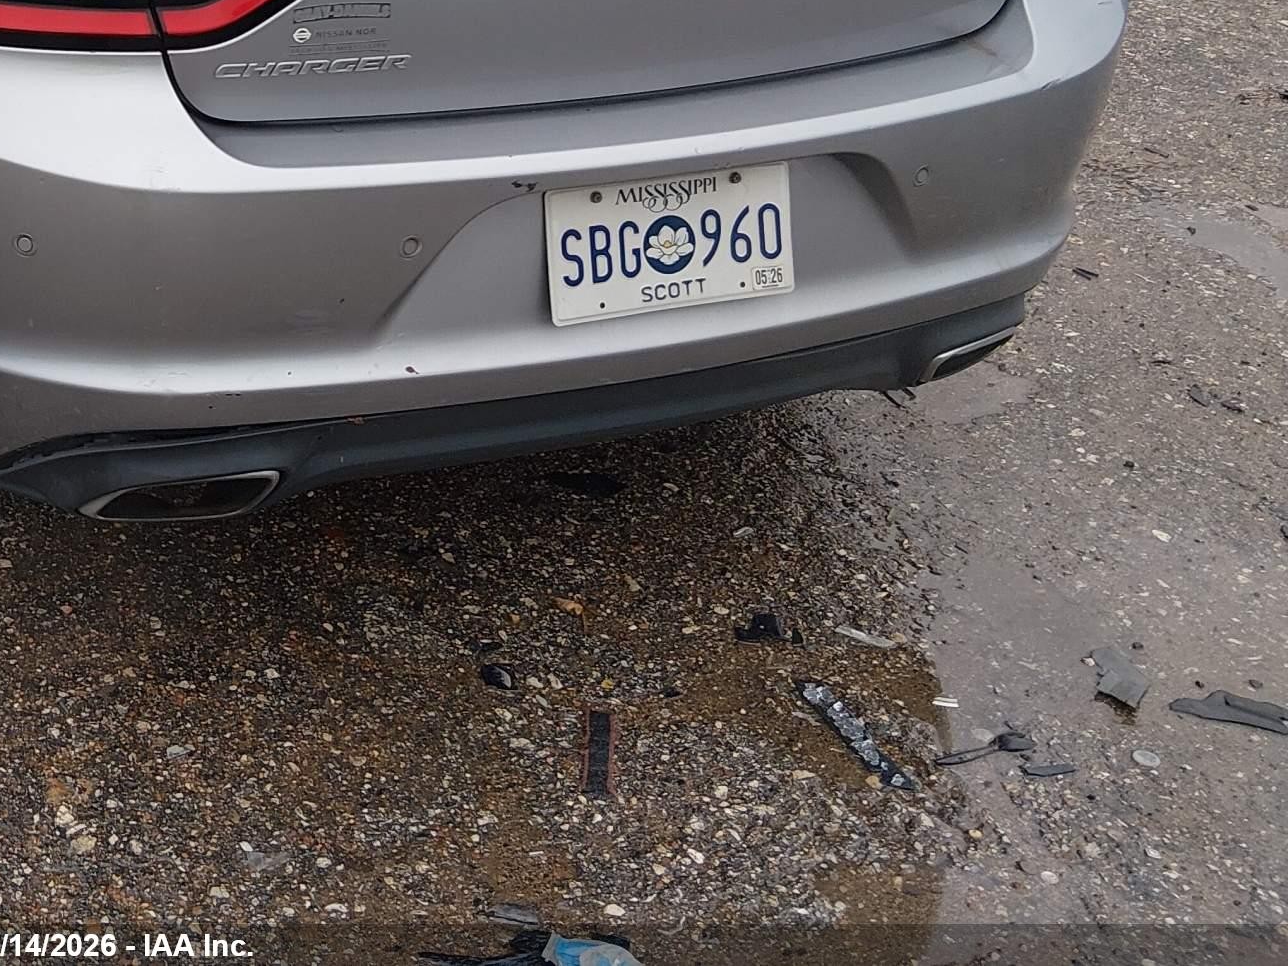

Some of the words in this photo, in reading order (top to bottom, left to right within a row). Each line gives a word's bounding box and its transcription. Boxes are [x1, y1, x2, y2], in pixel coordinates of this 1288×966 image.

[214, 52, 412, 79] CHARGER
[615, 175, 718, 214] MISSISSIPPI
[700, 202, 783, 267] 960
[640, 277, 708, 303] SCOTT
